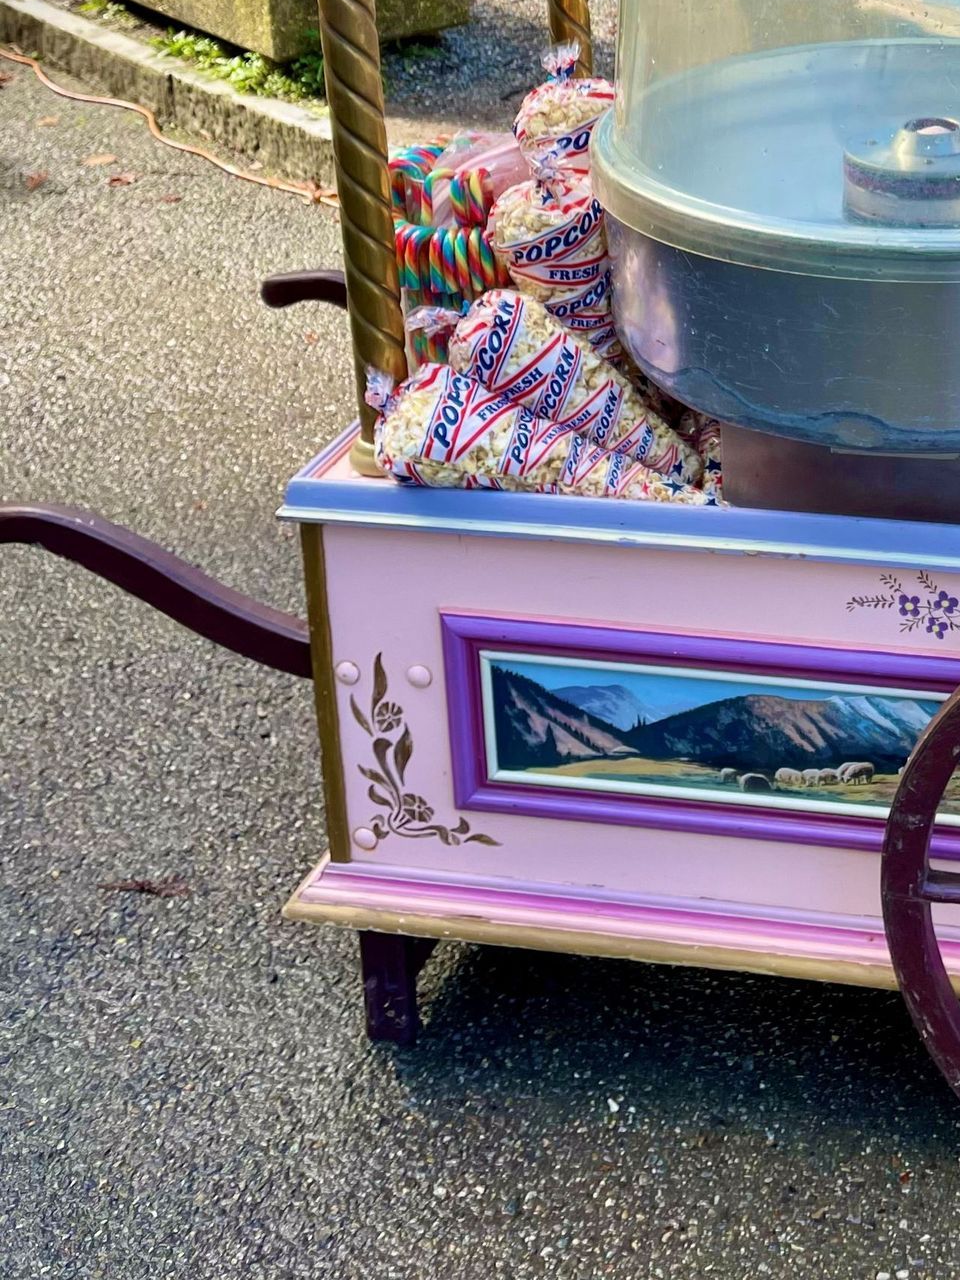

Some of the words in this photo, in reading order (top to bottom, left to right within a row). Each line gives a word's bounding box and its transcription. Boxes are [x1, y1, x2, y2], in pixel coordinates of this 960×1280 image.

[513, 198, 603, 264] POPCOR
[549, 264, 600, 281] FRESH
[476, 298, 515, 385] PCORN
[433, 376, 471, 449] POPC
[540, 346, 575, 417] PCORN
[593, 390, 618, 445] PCORN
